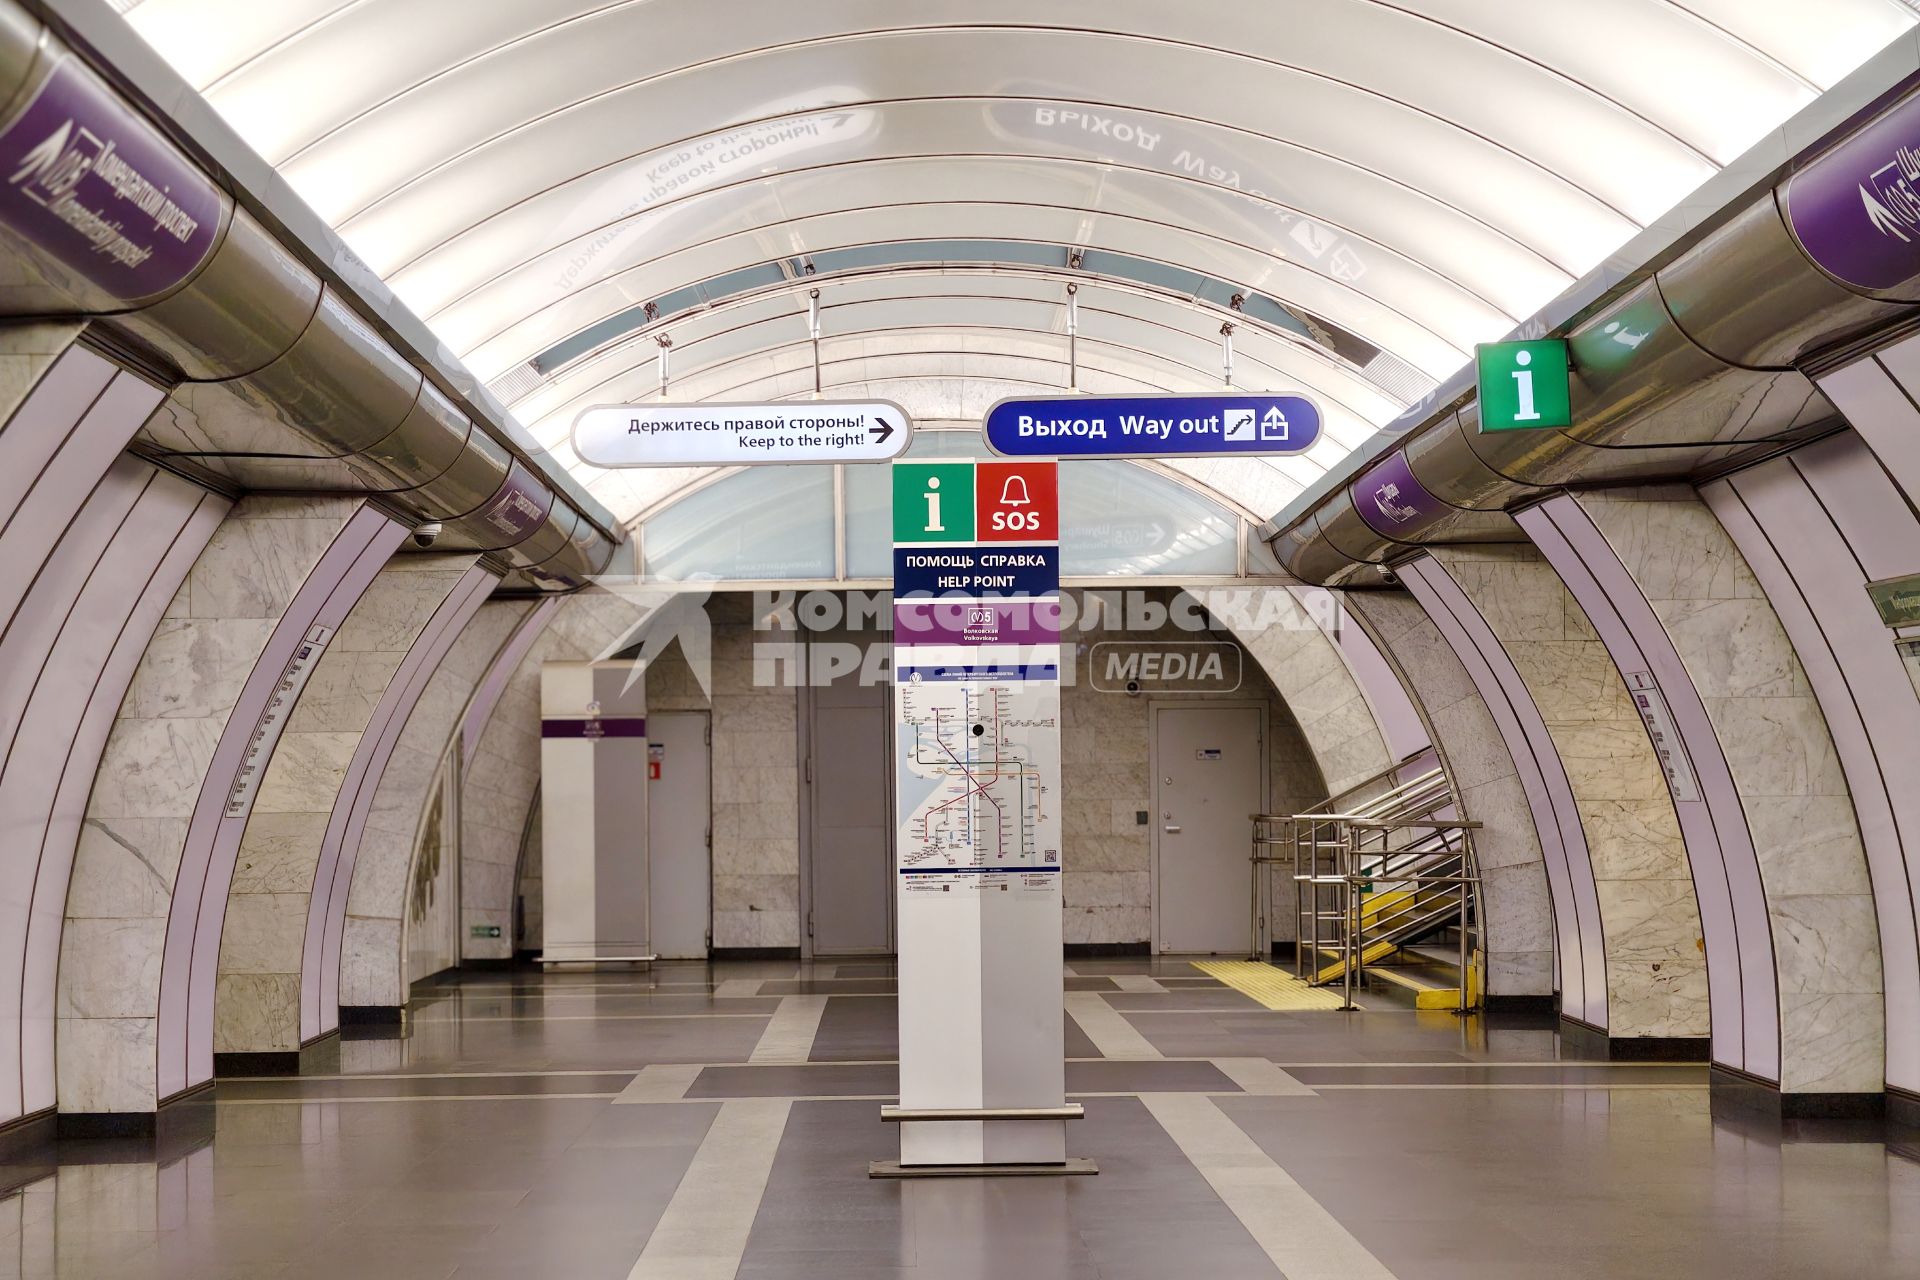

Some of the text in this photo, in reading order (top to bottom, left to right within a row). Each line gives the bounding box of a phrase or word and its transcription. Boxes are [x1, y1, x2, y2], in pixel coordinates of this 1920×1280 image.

[628, 415, 864, 435] Держитесь правой стороны!
[1018, 415, 1107, 439] Выход
[1119, 415, 1220, 439] Way out
[739, 434, 864, 450] Keep to the right!
[992, 511, 1040, 531] SOS
[906, 555, 1046, 568] ПОМОЩЬ СПРАВКА
[938, 575, 1015, 588] HELP POINT
[984, 612, 991, 623] 5
